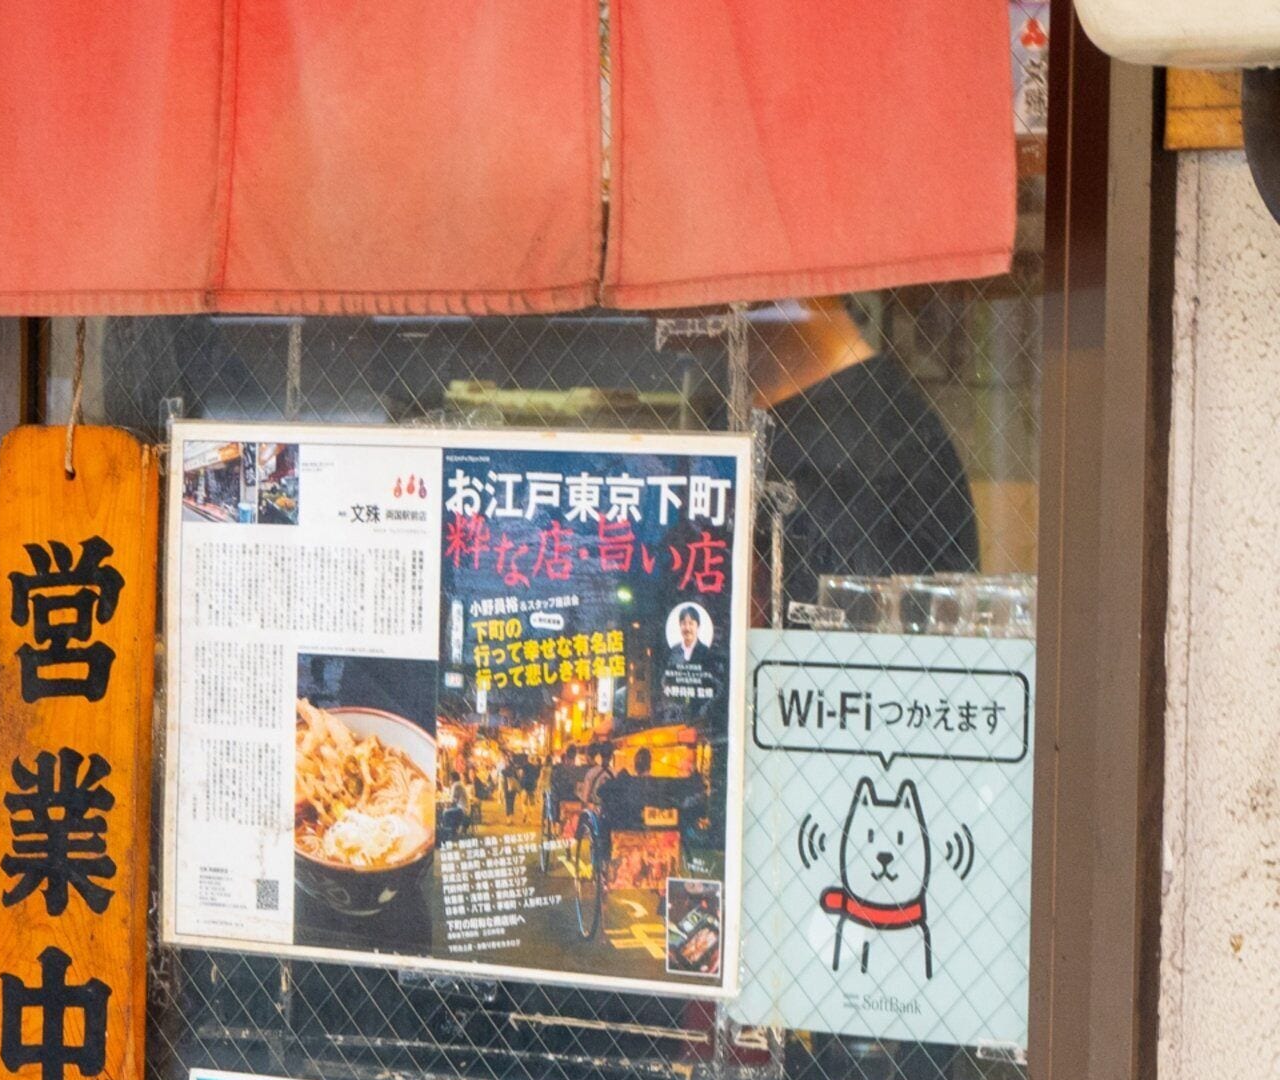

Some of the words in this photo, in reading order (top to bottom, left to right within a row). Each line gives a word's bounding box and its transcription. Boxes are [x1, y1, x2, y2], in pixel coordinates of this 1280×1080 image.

[445, 469, 731, 527] お江戸東京下町
[445, 511, 728, 594] 粋な店・旨い店
[861, 996, 923, 1015] SoftBank
